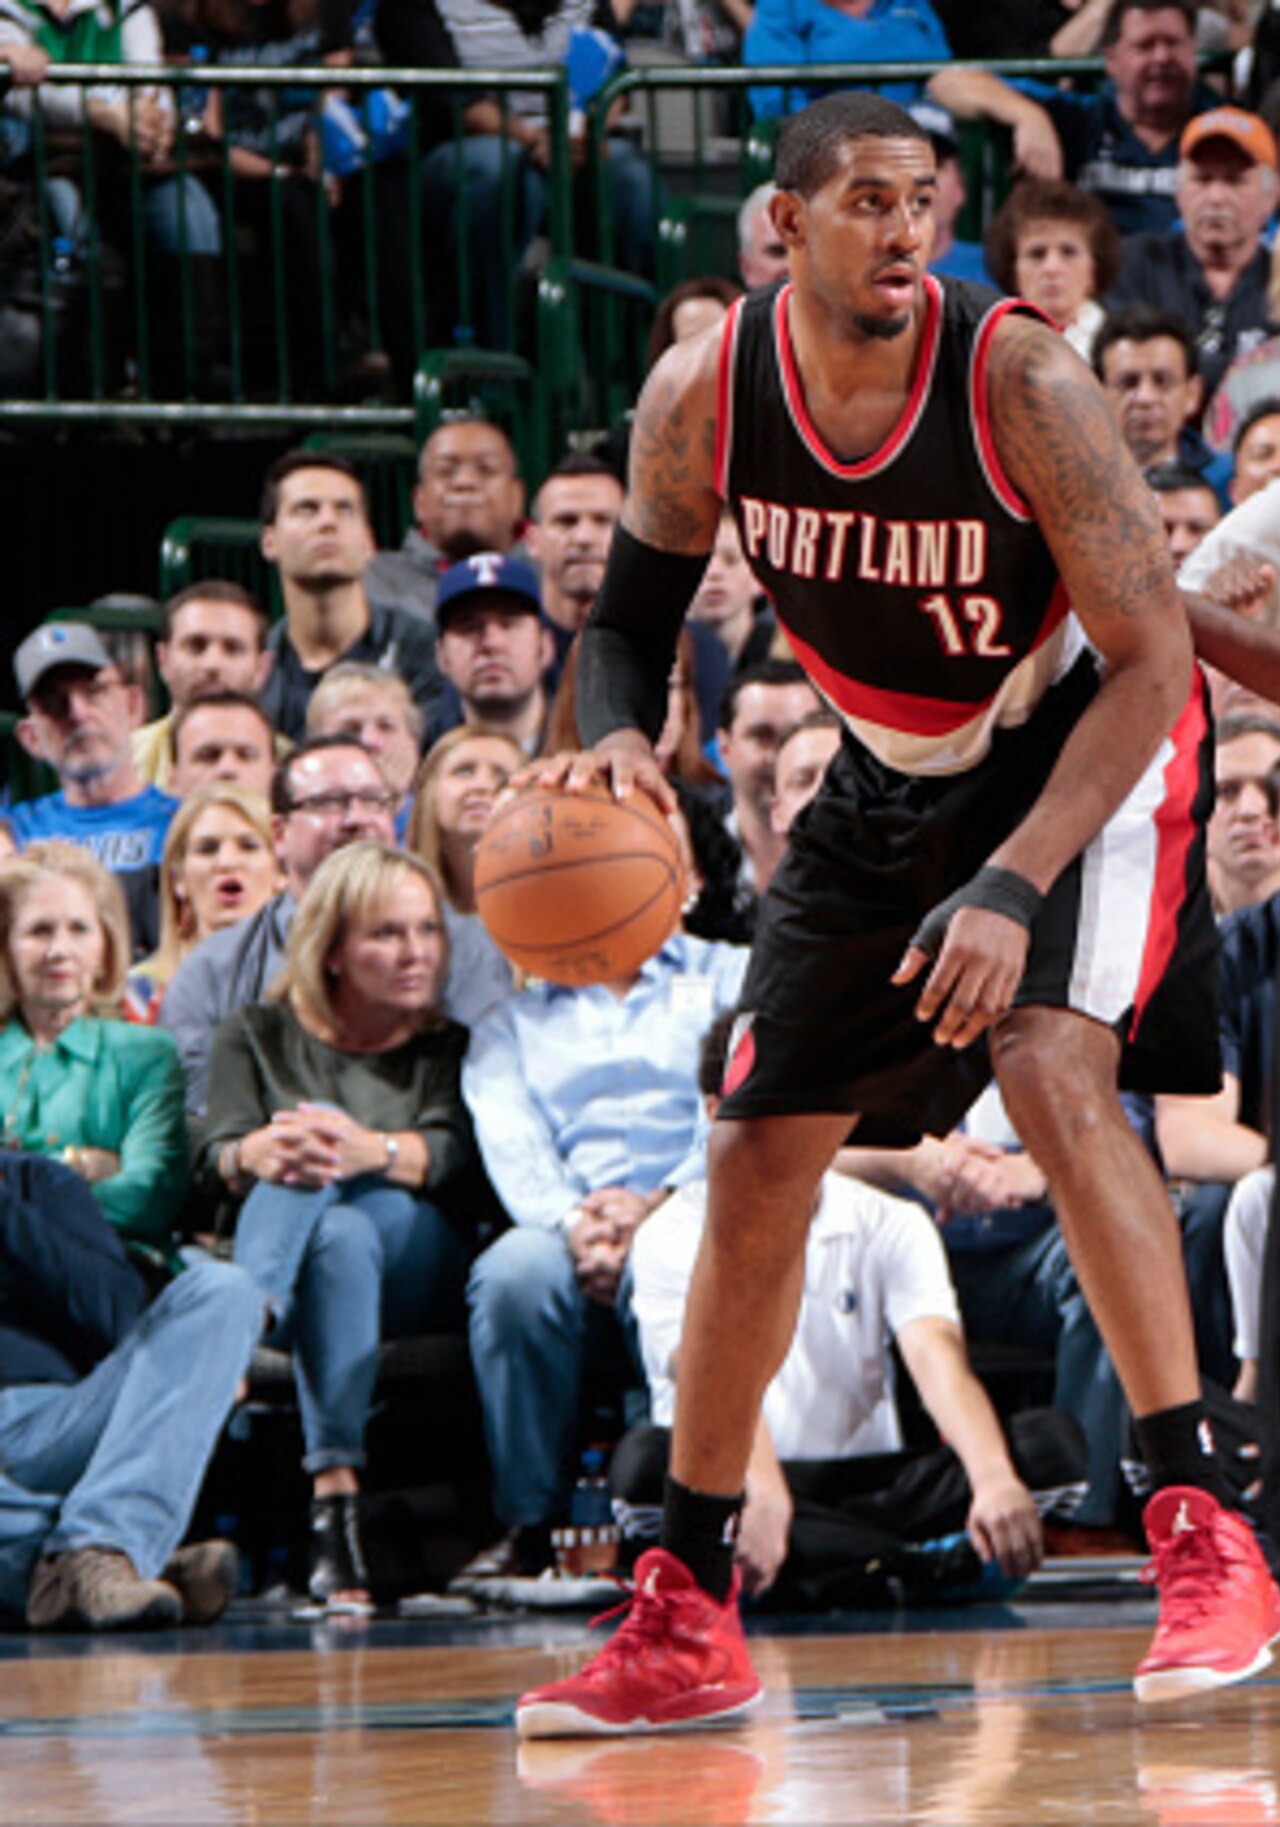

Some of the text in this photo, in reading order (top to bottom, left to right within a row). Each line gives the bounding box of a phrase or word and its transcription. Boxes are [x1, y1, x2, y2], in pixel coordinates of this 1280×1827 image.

[466, 551, 504, 586] T
[740, 495, 986, 587] PORTLAND
[919, 593, 1012, 657] 12
